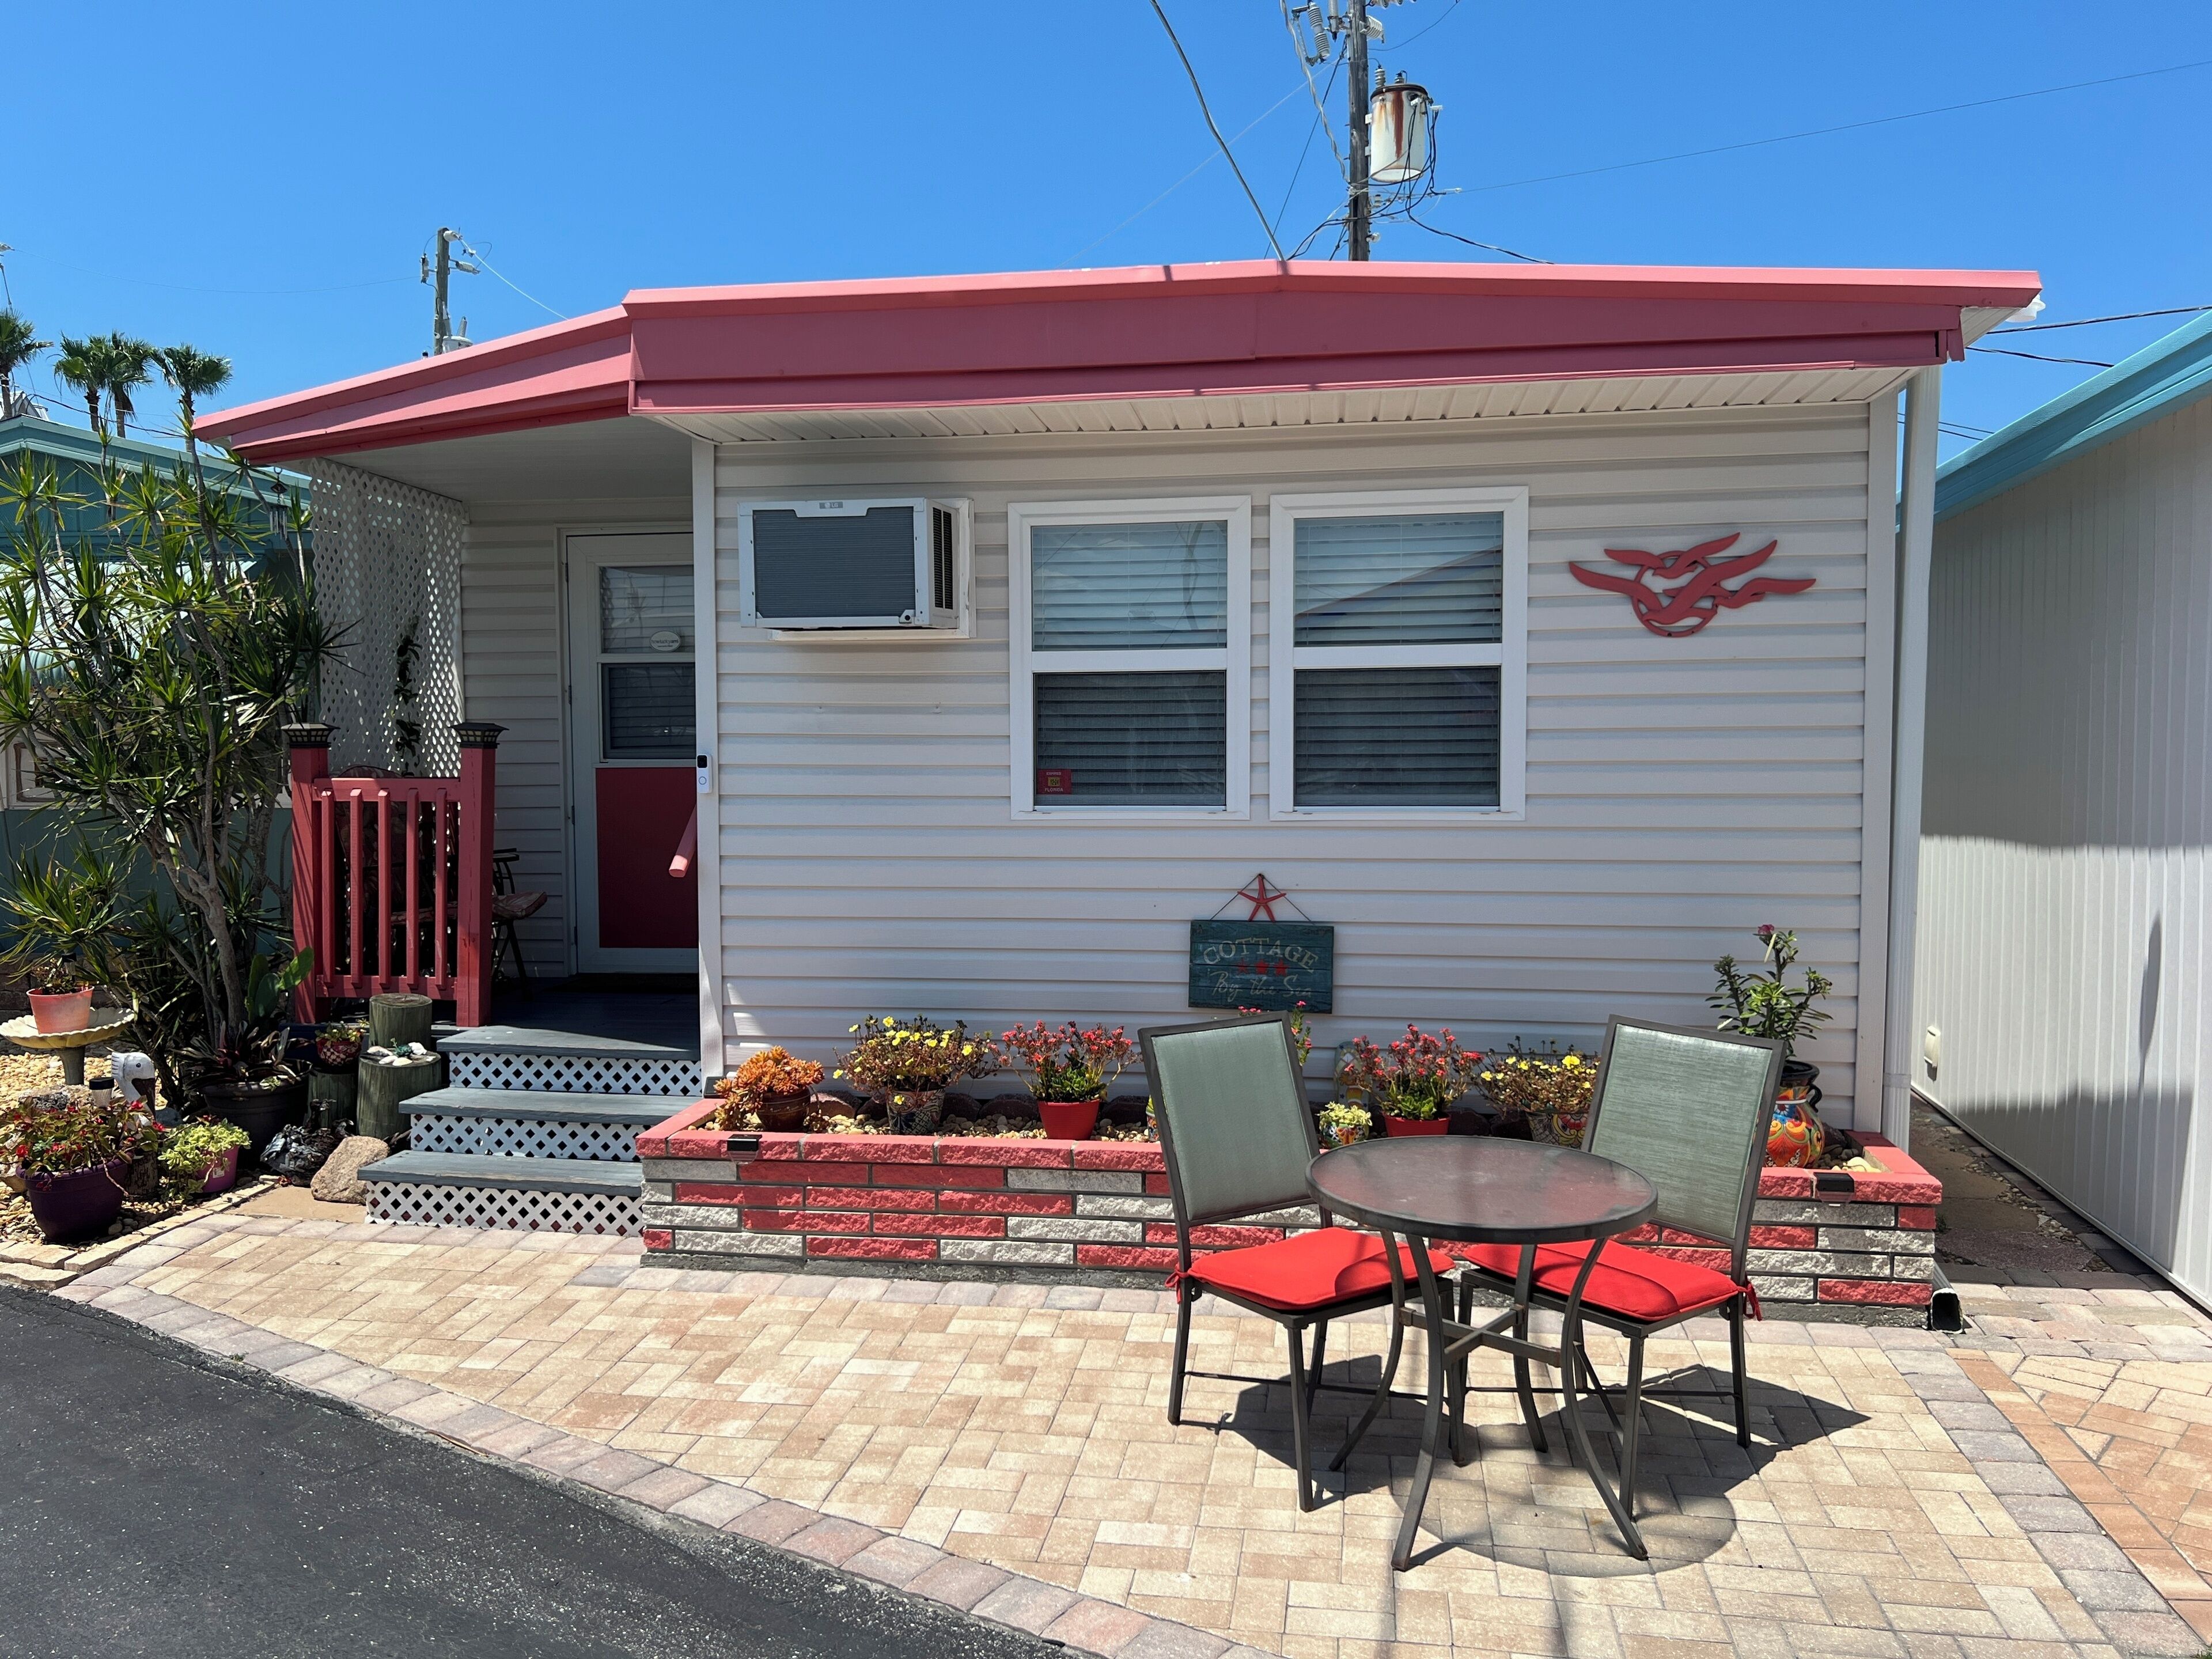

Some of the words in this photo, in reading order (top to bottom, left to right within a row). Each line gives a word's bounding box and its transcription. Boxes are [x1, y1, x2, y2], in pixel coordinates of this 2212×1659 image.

[1203, 937, 1319, 973] COTTAGE
[1210, 971, 1243, 1002] By
[1250, 976, 1276, 996] the
[1283, 974, 1312, 998] Sea
